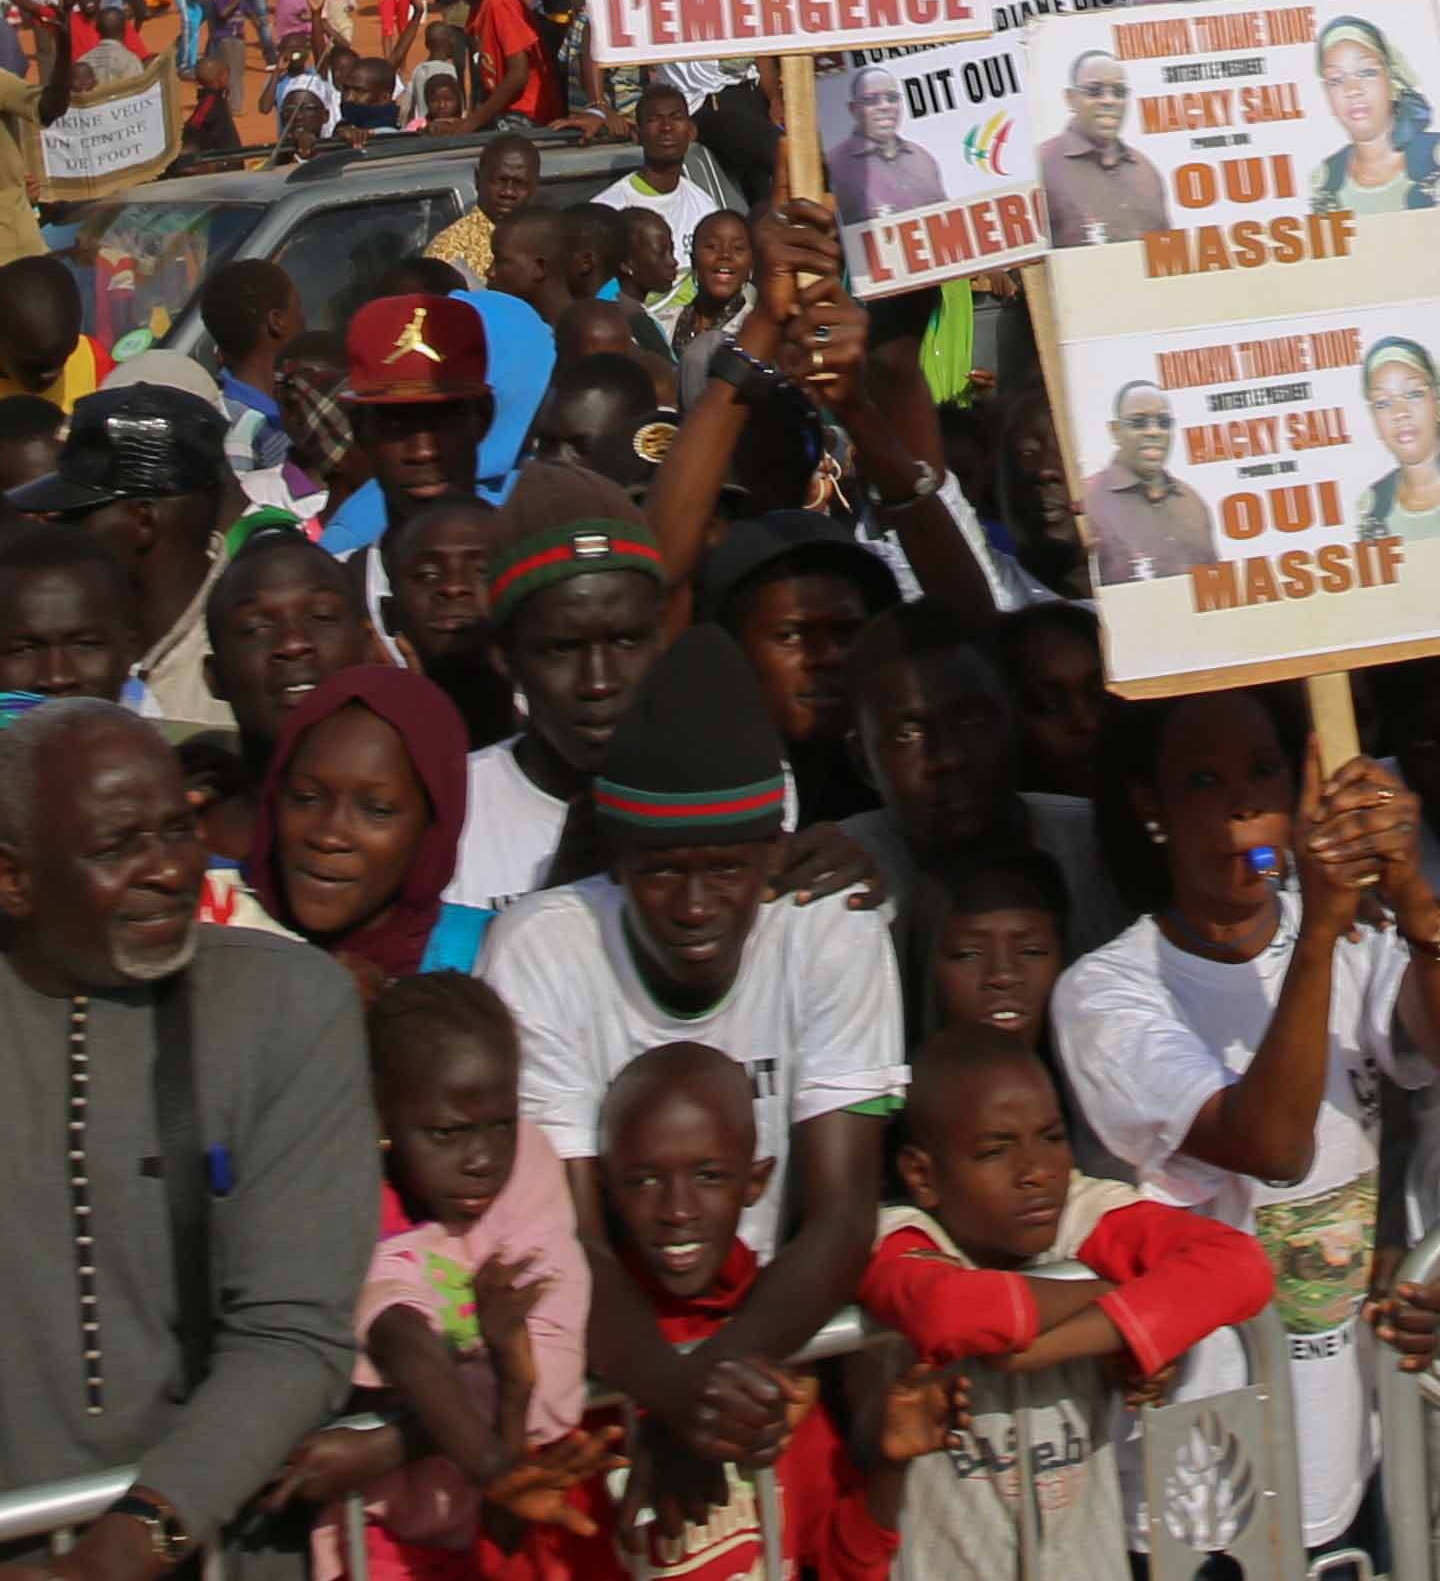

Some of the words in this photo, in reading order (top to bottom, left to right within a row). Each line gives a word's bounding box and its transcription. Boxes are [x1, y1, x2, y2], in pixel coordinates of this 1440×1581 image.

[902, 69, 957, 120] DIT
[962, 53, 1021, 104] OUI
[1137, 89, 1234, 135] MACKY
[1241, 82, 1305, 124] SALL
[98, 144, 142, 165] FOOT
[1172, 154, 1298, 210] OUI
[1142, 210, 1357, 279] MASSIF
[1183, 417, 1281, 465] MACKY
[1287, 407, 1353, 452] SALL
[1221, 480, 1345, 540] OUI
[1190, 535, 1405, 614] MASSIF
